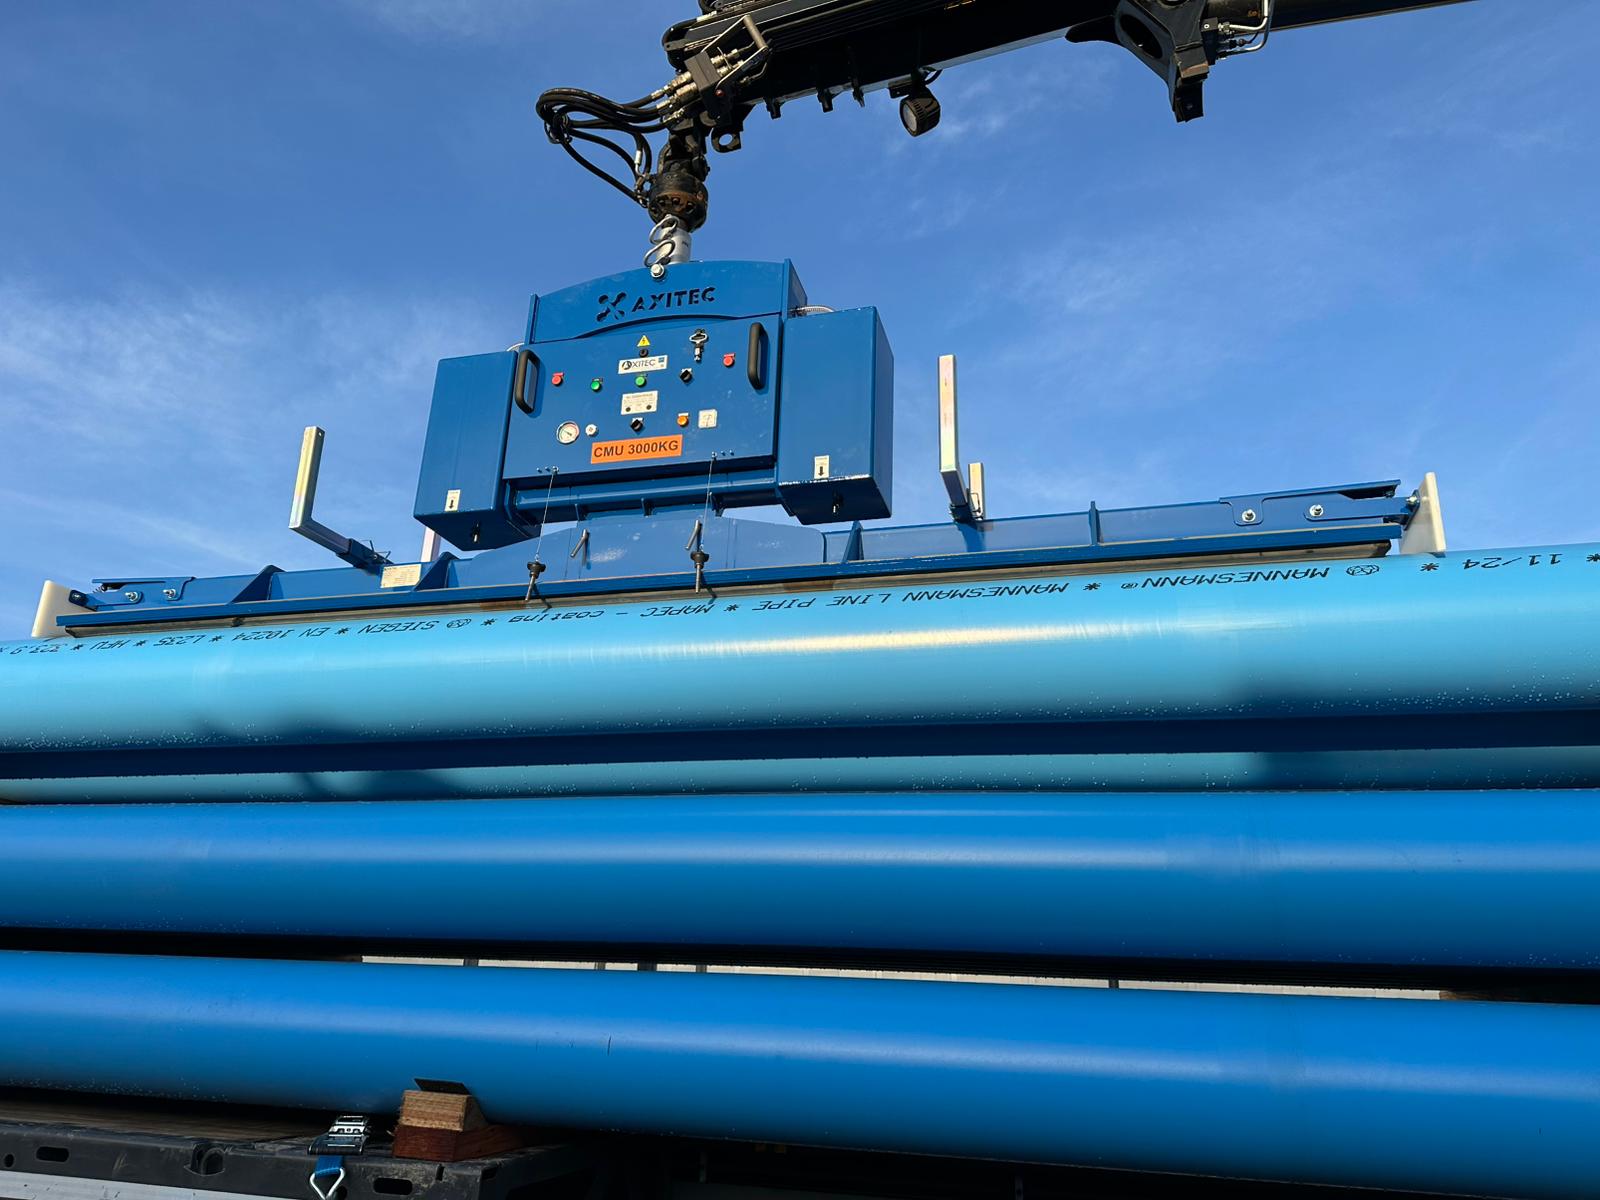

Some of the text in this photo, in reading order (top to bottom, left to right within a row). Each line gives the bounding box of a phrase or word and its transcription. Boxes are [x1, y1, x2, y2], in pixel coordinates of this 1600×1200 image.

[631, 286, 716, 312] AXITEC
[593, 440, 679, 458] CMU 3000KG
[1462, 553, 1564, 570] 11/24
[902, 582, 1070, 602] MANNESMANN
[751, 597, 817, 611] PIPE
[826, 593, 892, 606] LINE
[508, 610, 605, 623] coating
[639, 603, 715, 617] MAPEC
[298, 627, 331, 638] EN
[357, 620, 440, 634] SIEGEN
[232, 629, 295, 642] 10224
